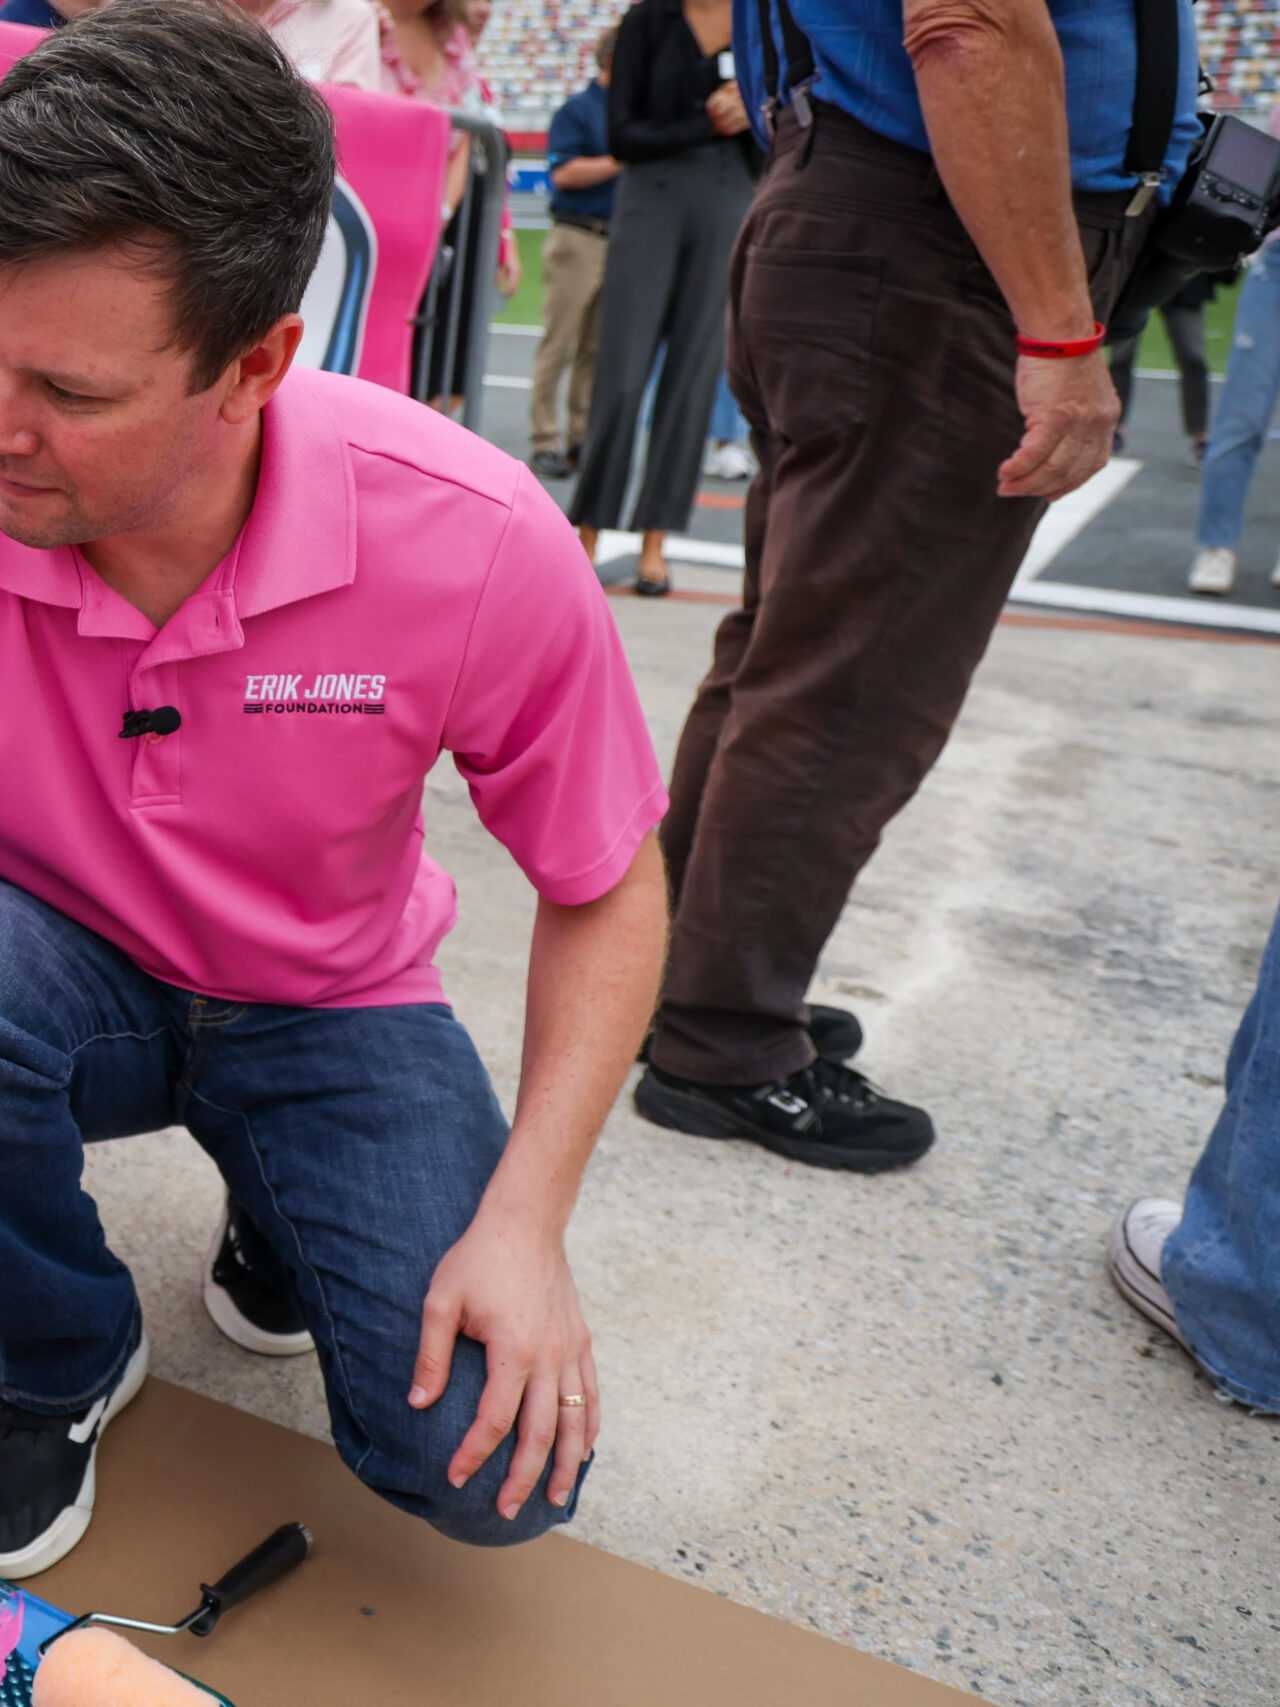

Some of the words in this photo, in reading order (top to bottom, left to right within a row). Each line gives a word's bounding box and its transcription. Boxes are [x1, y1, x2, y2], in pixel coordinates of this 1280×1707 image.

[244, 674, 303, 701] ERIK
[303, 673, 387, 701] JONES
[265, 702, 363, 714] FOUNDATION
